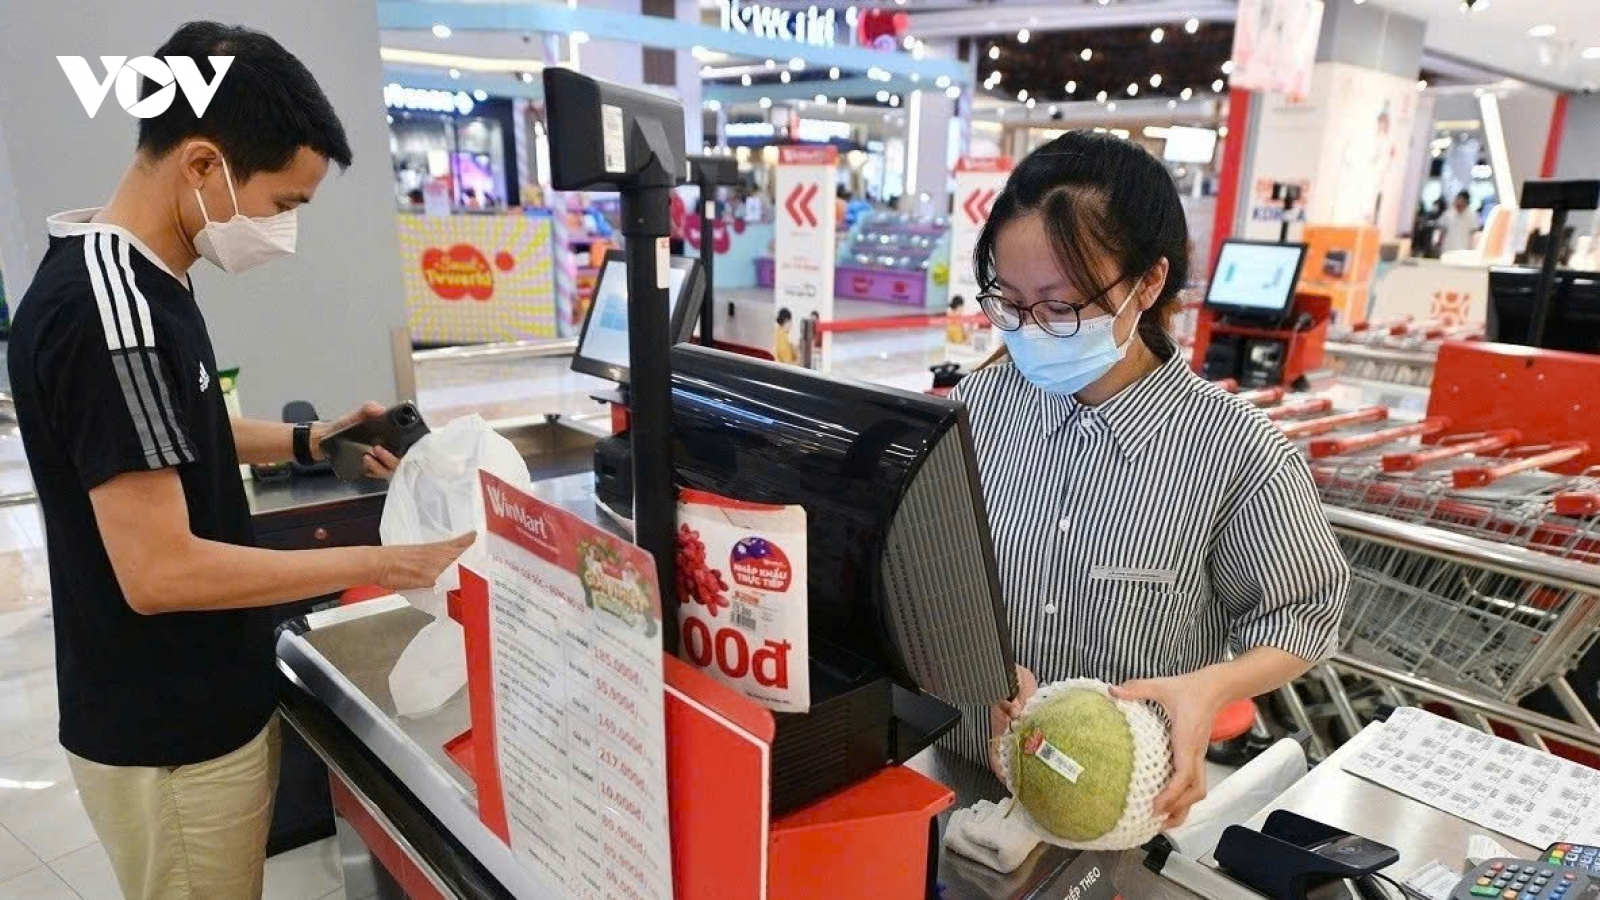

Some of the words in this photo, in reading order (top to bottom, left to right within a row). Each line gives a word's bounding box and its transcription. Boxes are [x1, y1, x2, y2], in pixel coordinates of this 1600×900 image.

[1253, 206, 1307, 221] KORA
[486, 484, 548, 539] WinMart
[1079, 866, 1101, 891] THEO
